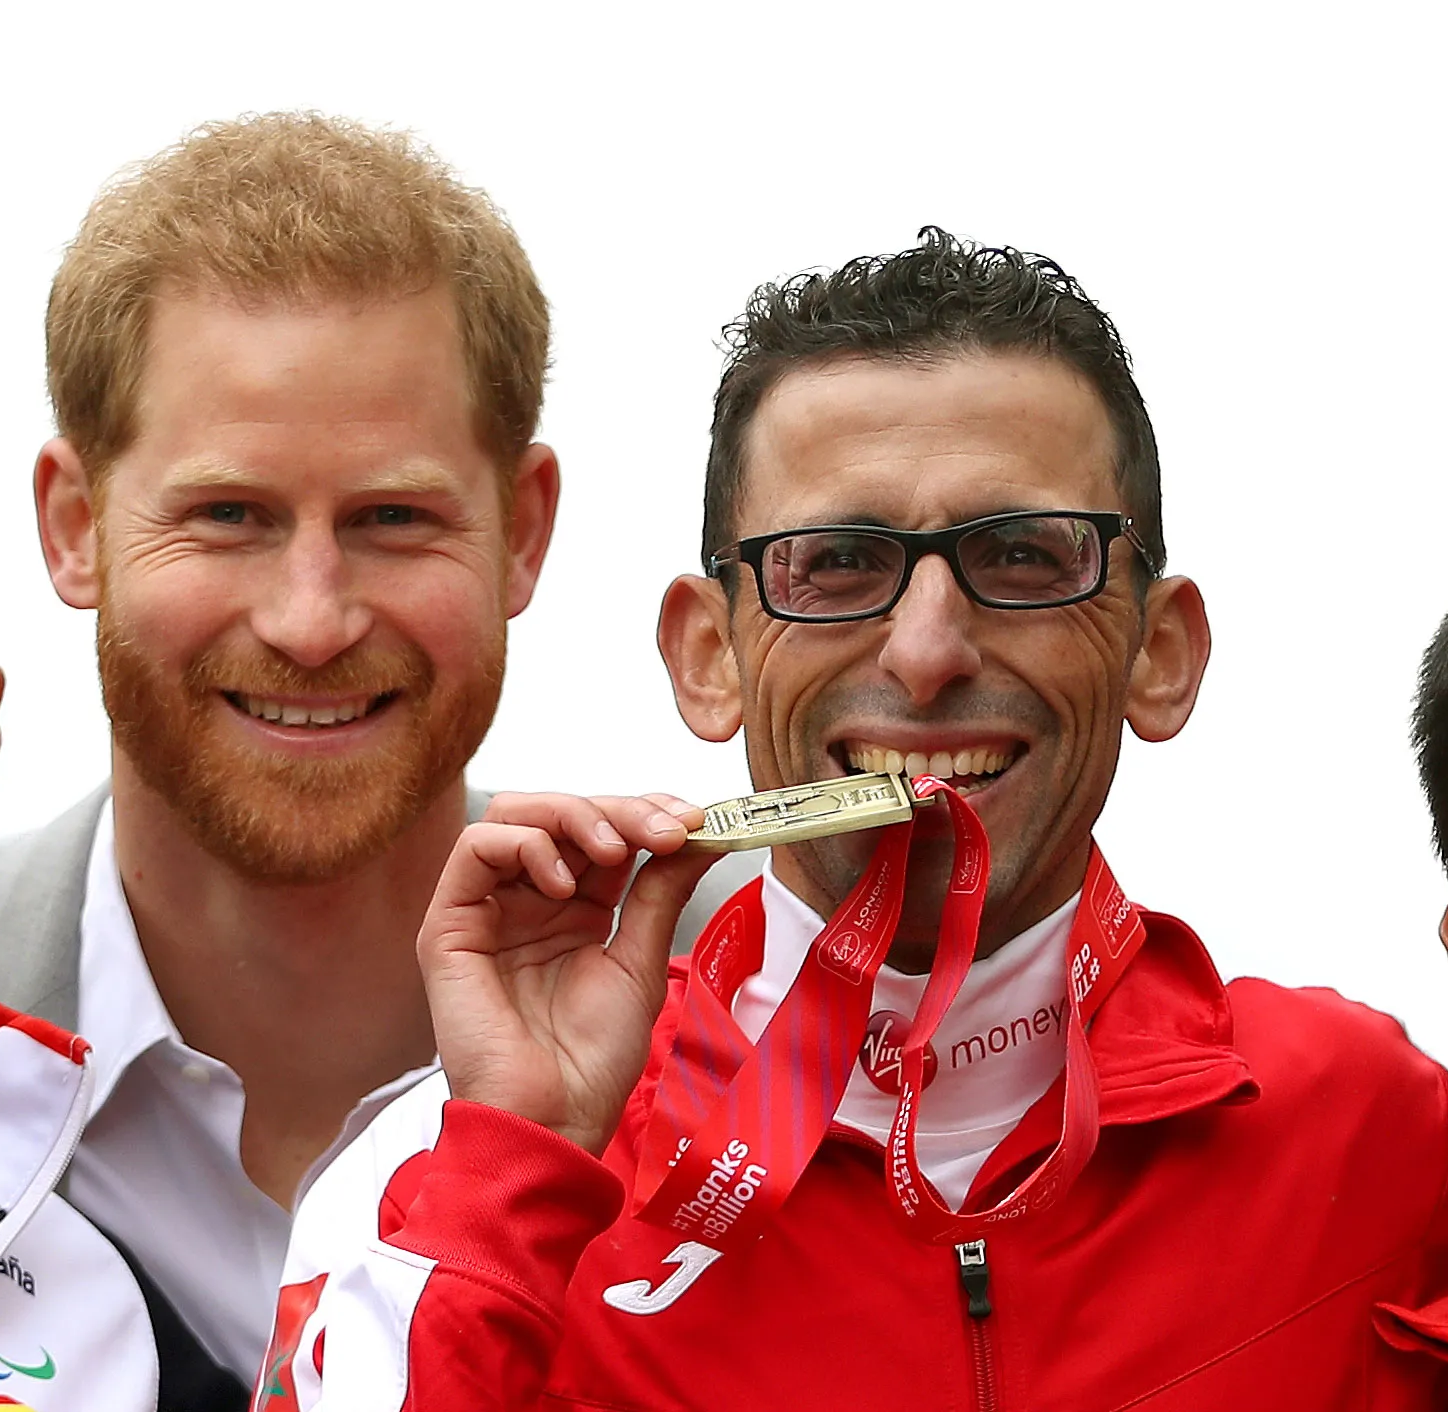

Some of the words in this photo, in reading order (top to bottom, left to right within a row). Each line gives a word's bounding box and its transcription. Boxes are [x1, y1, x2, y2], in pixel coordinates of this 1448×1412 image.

[854, 861, 888, 926] LONDON
[951, 997, 1066, 1069] money
[669, 1139, 750, 1232] #Thanks
[701, 1163, 768, 1240] aBillion
